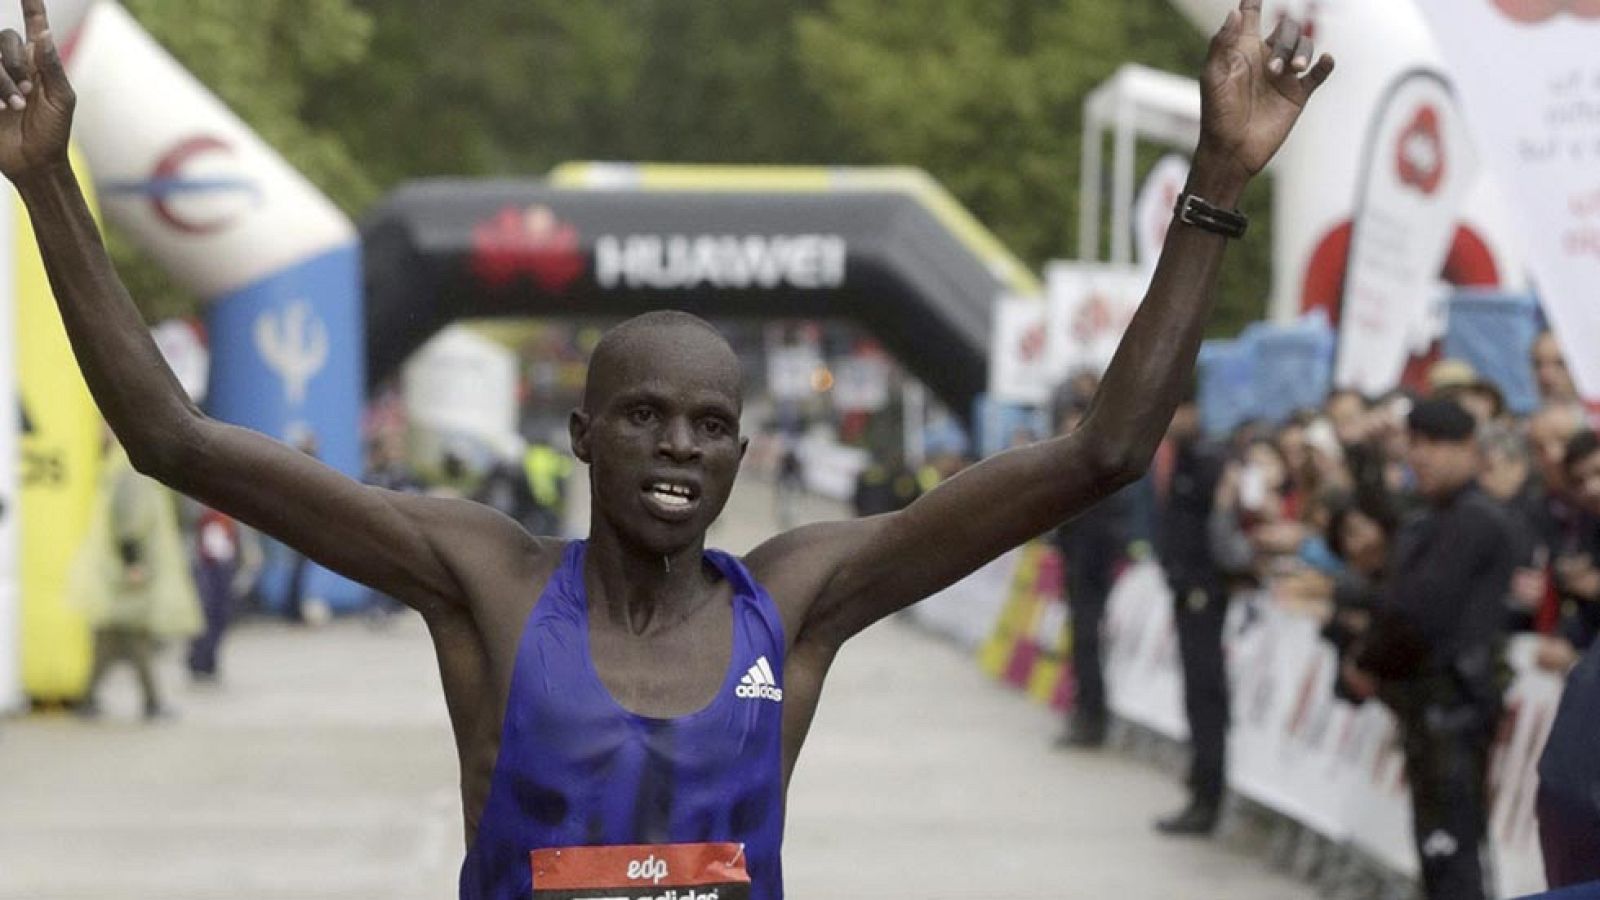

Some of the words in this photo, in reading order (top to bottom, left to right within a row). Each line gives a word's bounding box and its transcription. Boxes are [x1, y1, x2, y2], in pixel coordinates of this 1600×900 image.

[596, 235, 846, 289] HUAWEI
[735, 683, 782, 701] adidas
[627, 854, 668, 885] edp
